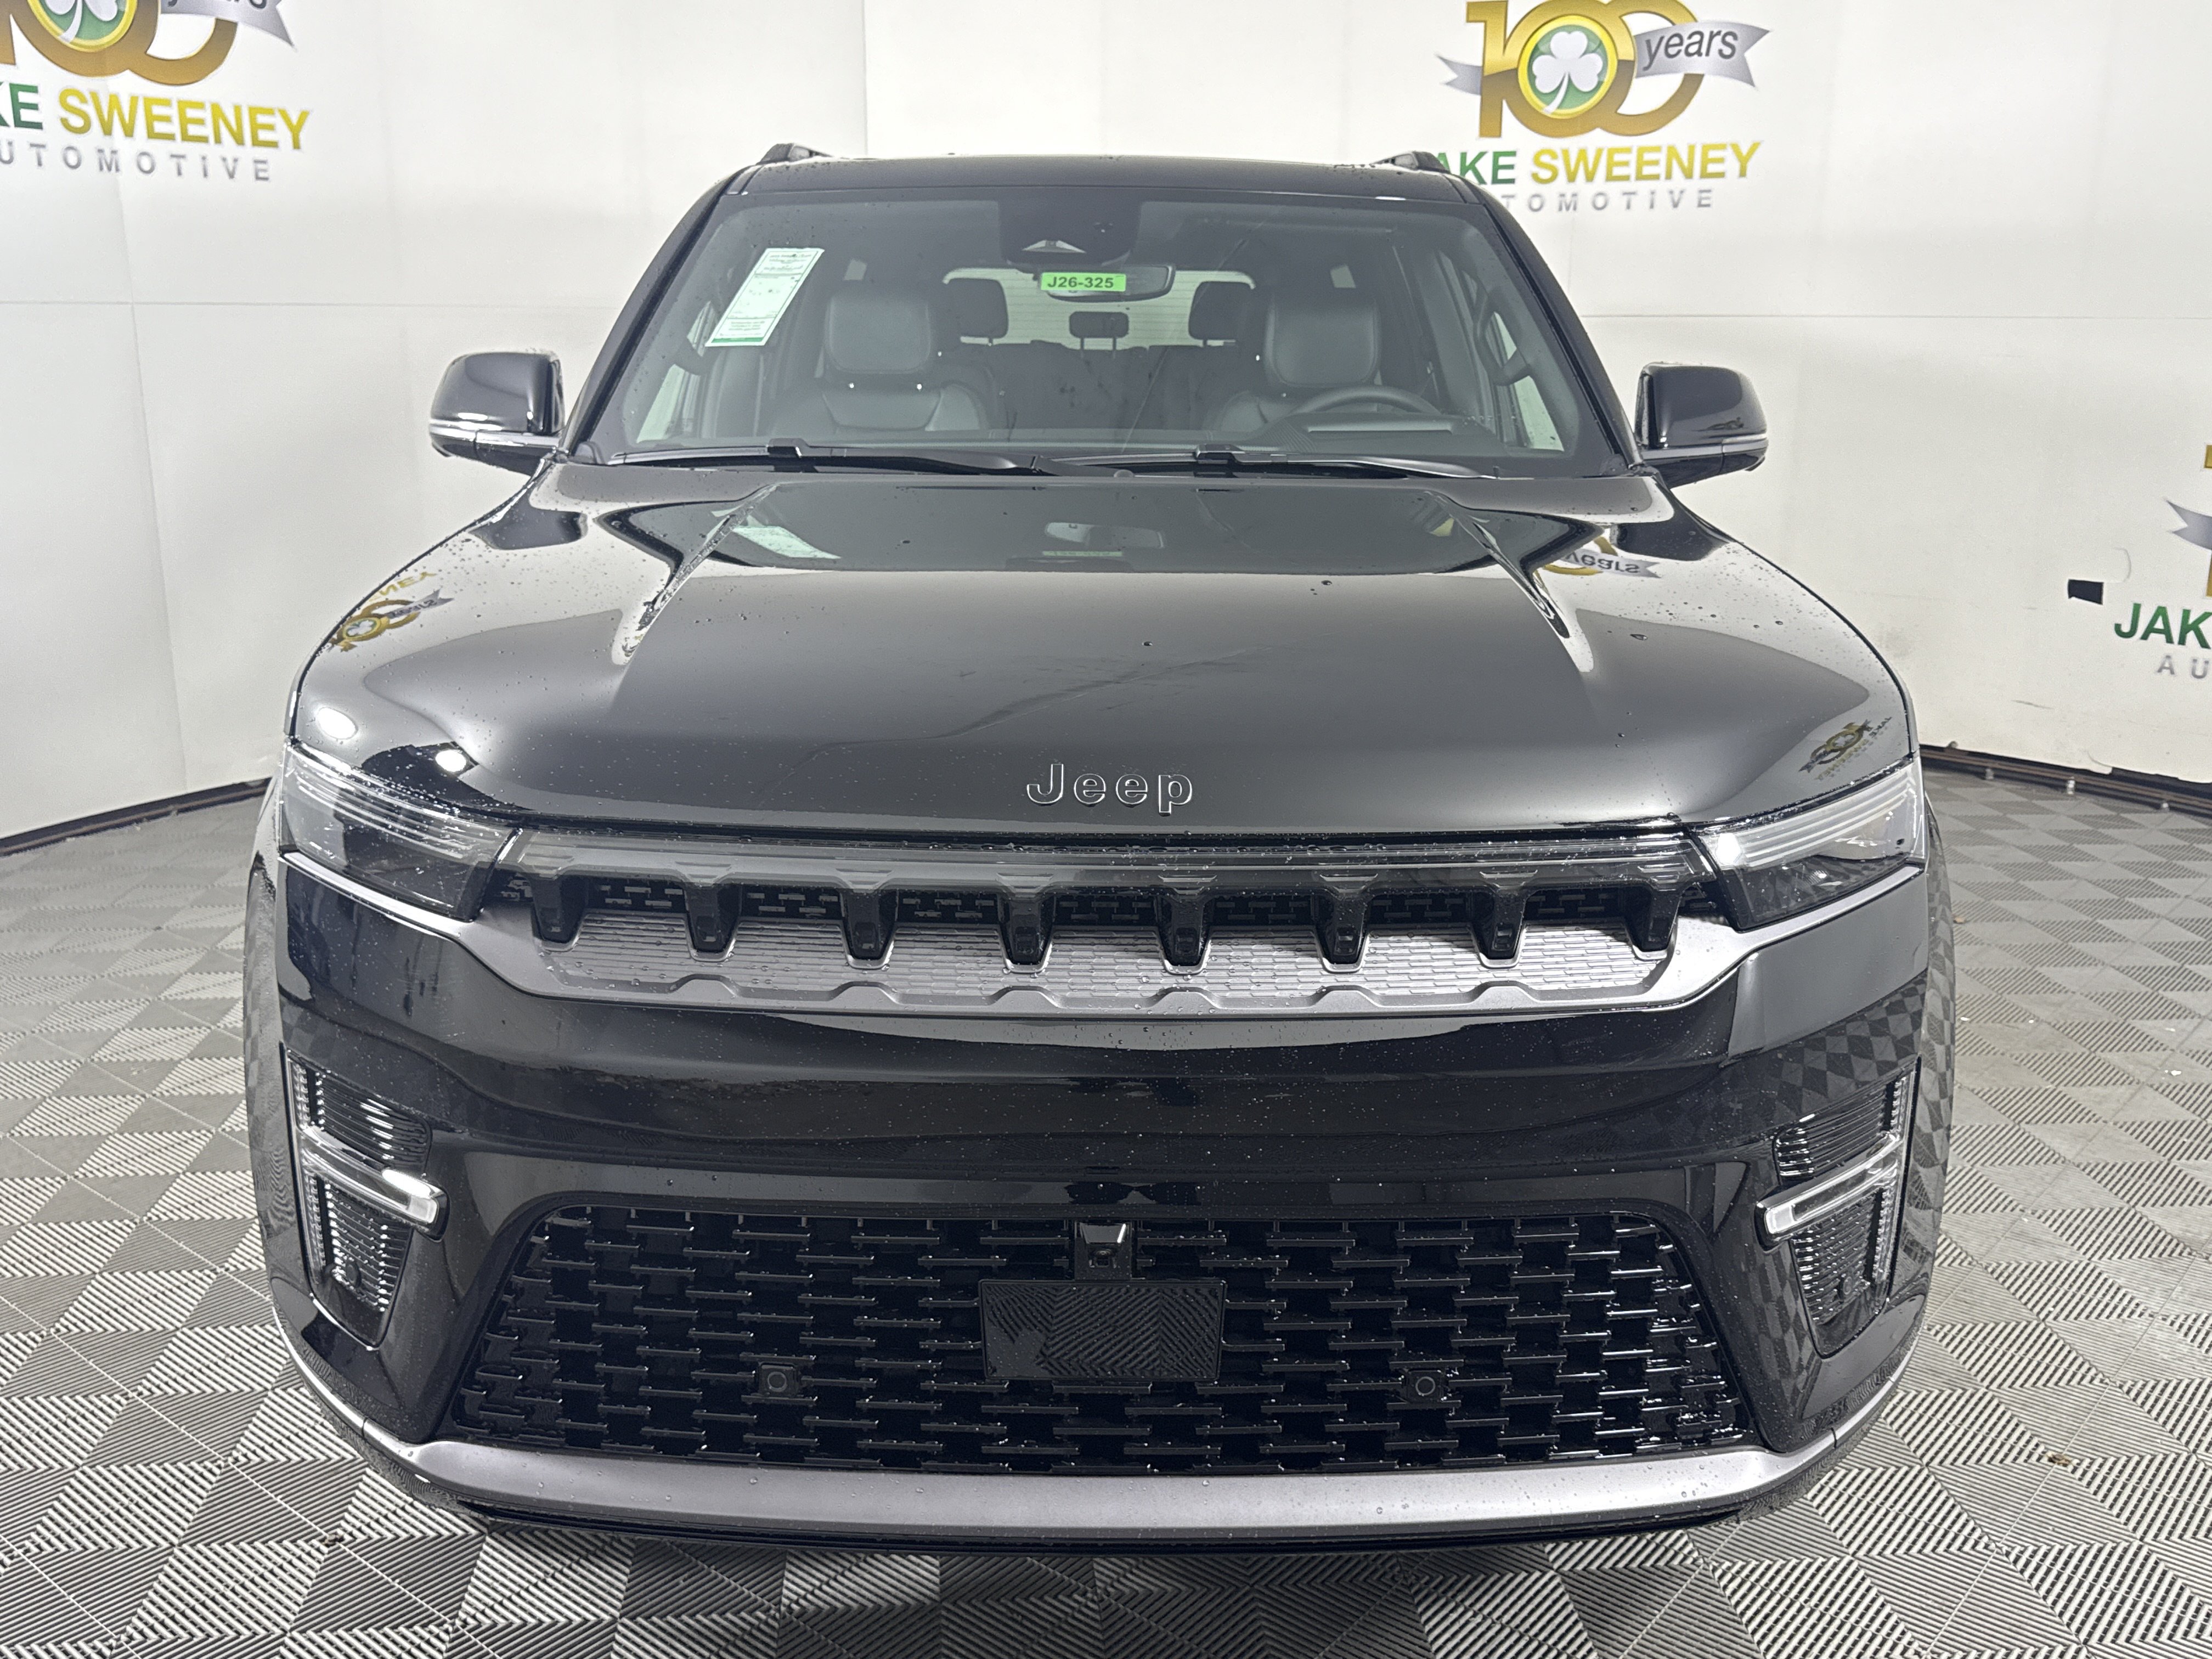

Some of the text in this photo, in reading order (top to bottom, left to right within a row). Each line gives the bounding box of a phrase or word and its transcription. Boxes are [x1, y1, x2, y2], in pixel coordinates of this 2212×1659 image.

[1644, 29, 1738, 71] years
[58, 88, 310, 150] SWEENEY
[1531, 142, 1762, 184] SWEENEY
[1047, 276, 1114, 289] J26-325
[1026, 763, 1193, 816] Jeep
